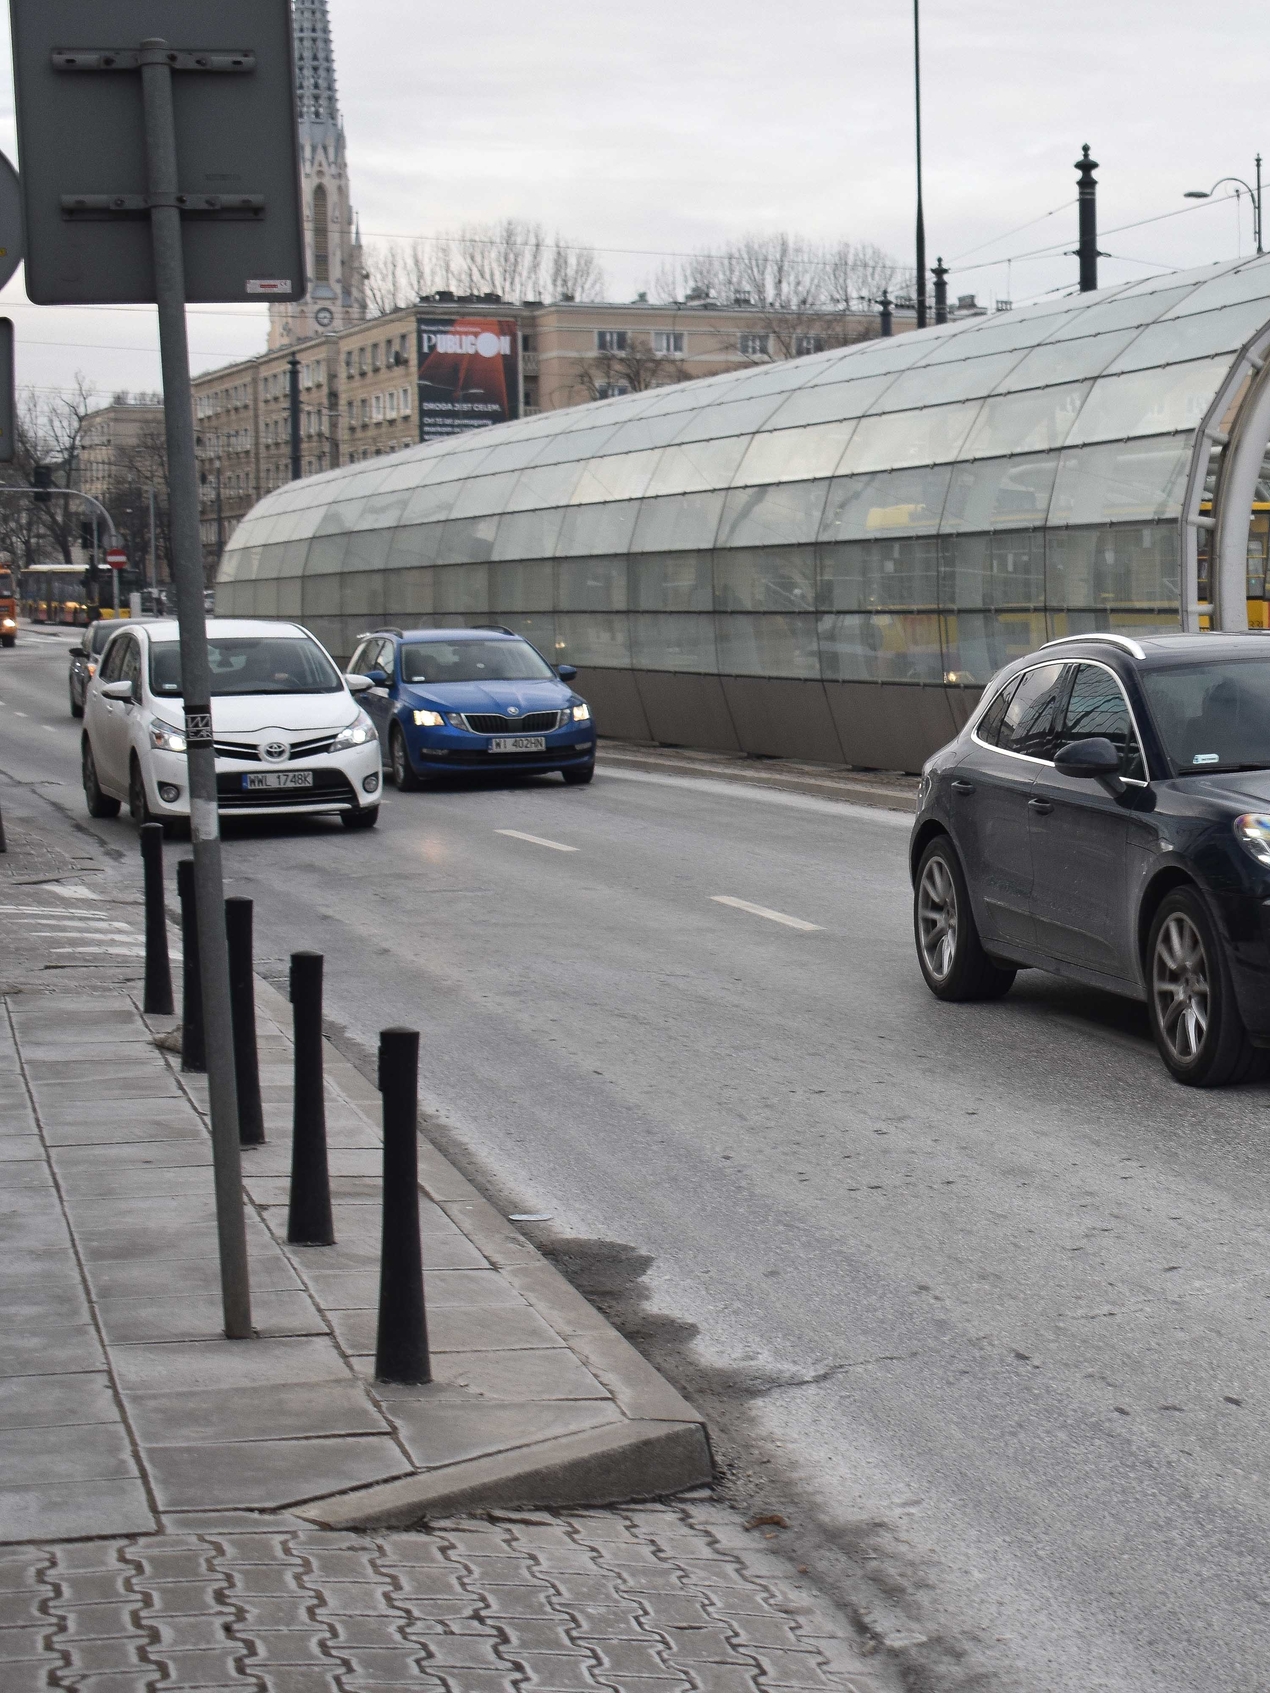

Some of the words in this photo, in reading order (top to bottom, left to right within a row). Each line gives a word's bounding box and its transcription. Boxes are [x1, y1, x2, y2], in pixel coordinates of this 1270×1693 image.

[422, 333, 511, 357] PUBLICON
[494, 739, 507, 749] WI
[512, 737, 543, 749] 402HN
[248, 774, 272, 788] WWL
[276, 772, 312, 786] 1748K
